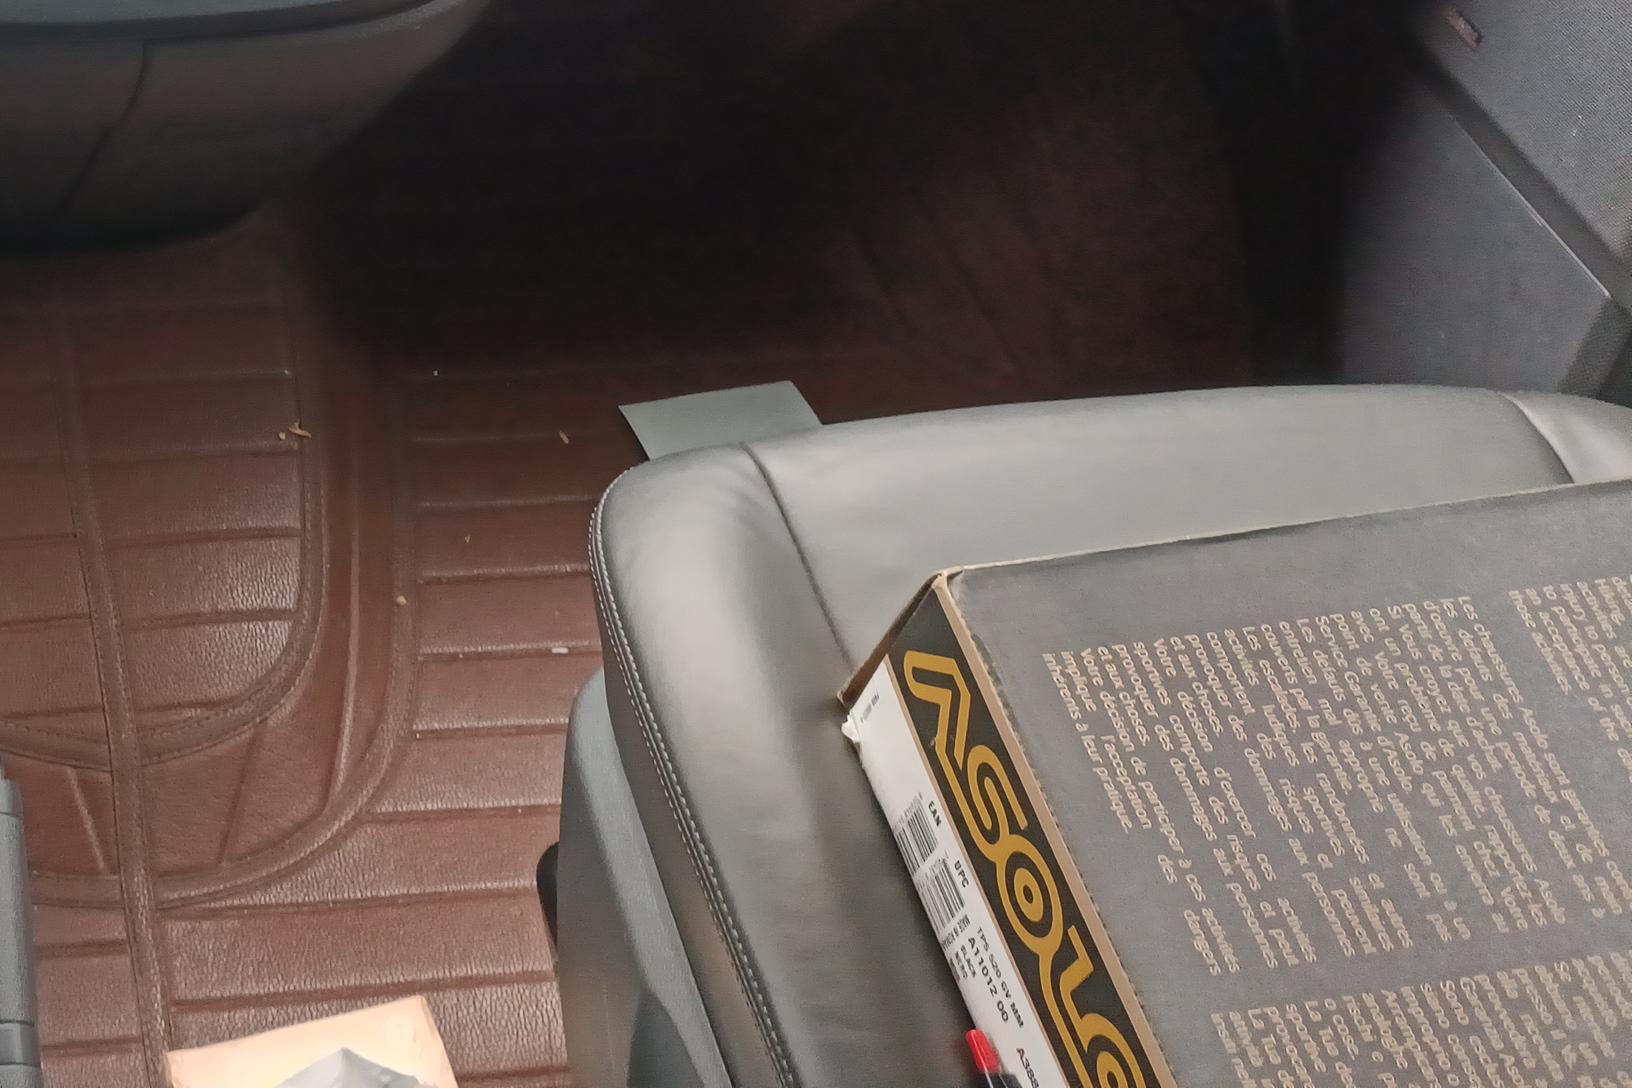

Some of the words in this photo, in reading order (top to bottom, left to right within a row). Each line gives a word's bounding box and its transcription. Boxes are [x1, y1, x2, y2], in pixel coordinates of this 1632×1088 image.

[928, 800, 942, 827] EAN
[954, 860, 969, 888] UPC
[976, 927, 990, 953] TPS
[968, 936, 998, 997] A11012
[996, 999, 1009, 1023] 00
